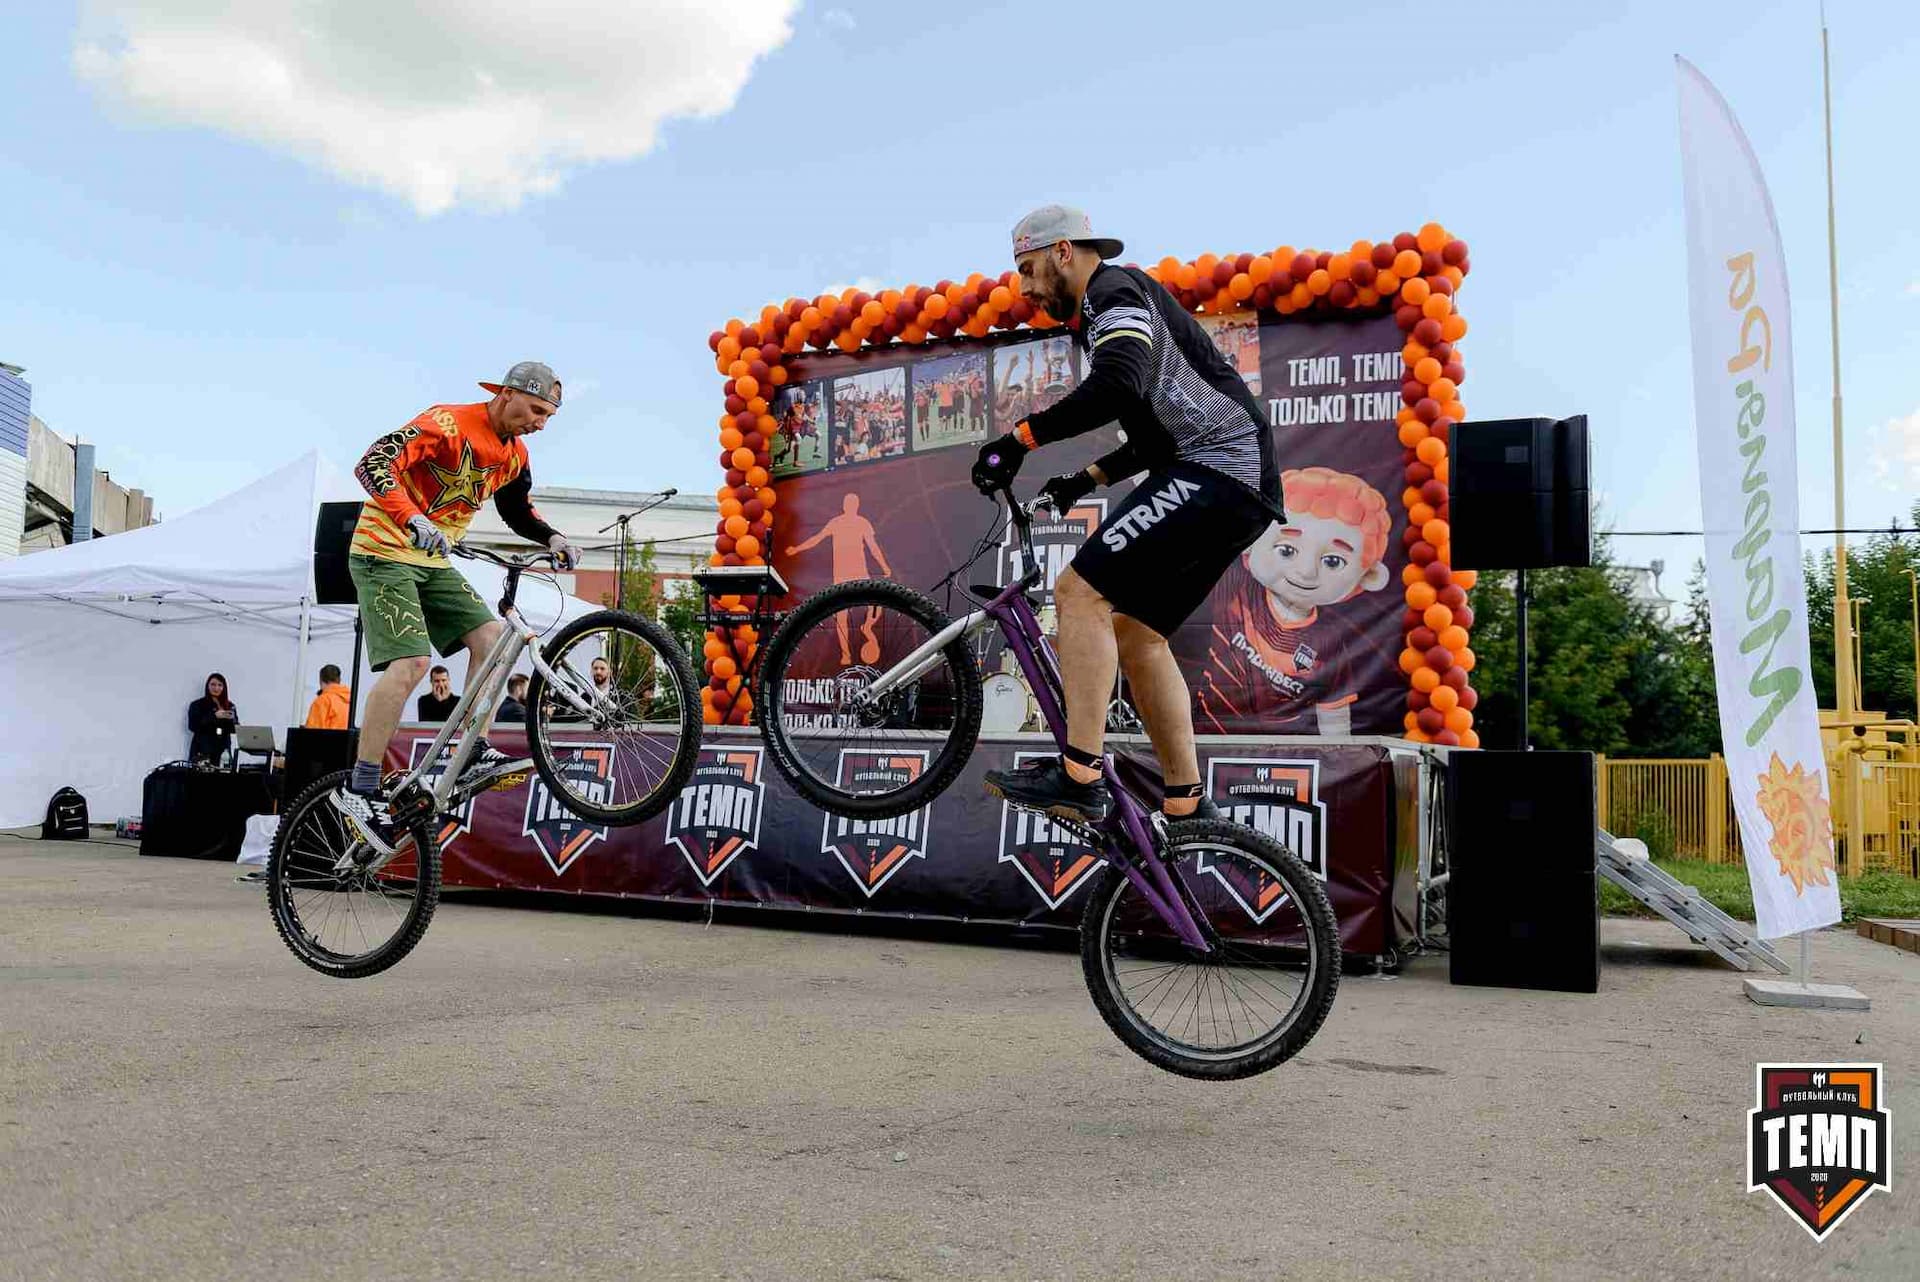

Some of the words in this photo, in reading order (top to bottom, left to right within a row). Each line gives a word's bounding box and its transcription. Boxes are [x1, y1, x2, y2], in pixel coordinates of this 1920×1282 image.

[1288, 356, 1347, 387] ТЕМП,
[1269, 394, 1346, 426] ТОЛЬКО
[1102, 477, 1202, 552] STRAVA
[1010, 543, 1081, 592] ТЕМ
[784, 714, 832, 728] ОЛЬКО
[680, 784, 754, 833] ТЕМП
